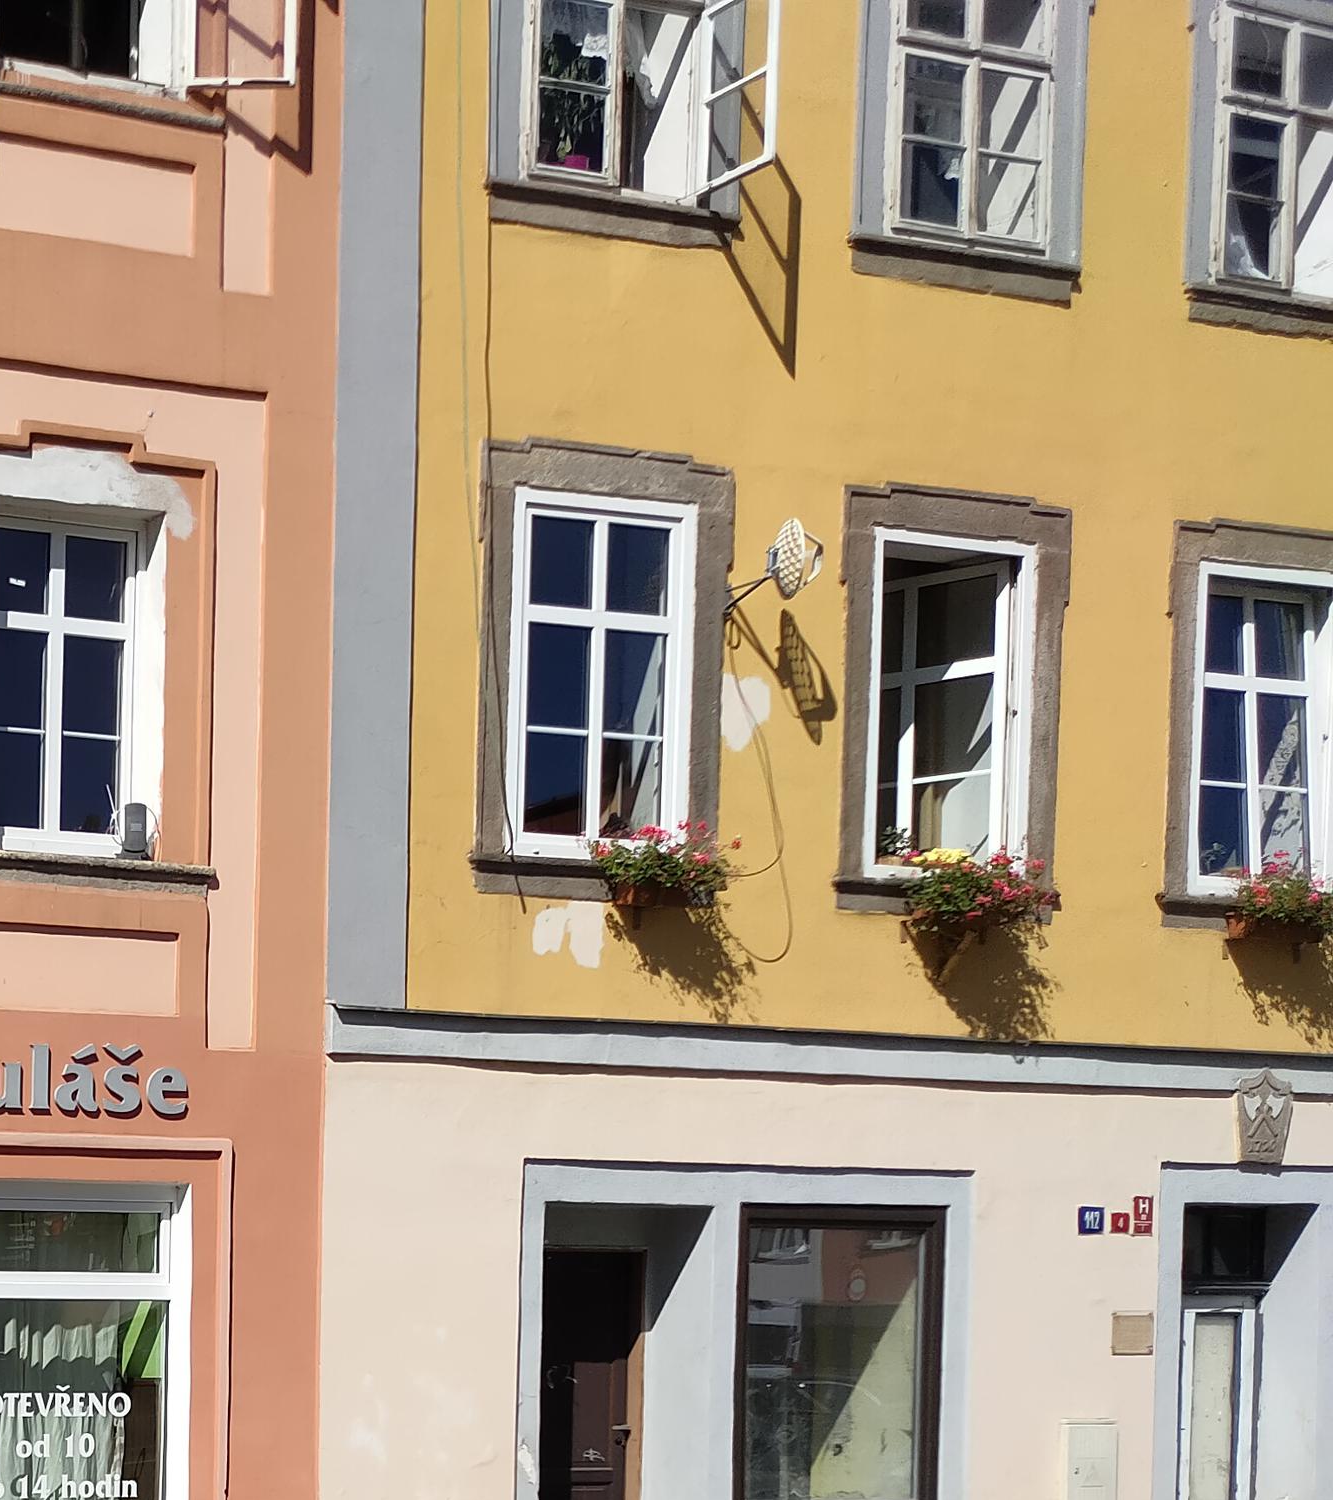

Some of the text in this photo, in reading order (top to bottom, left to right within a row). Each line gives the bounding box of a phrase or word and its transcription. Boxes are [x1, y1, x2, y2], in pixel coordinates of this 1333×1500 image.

[1139, 1199, 1149, 1214] H
[1084, 1210, 1101, 1230] 112
[1118, 1217, 1124, 1228] 4
[15, 1432, 96, 1459] od 10
[18, 1474, 51, 1500] 14
[61, 1473, 139, 1500] hodin
